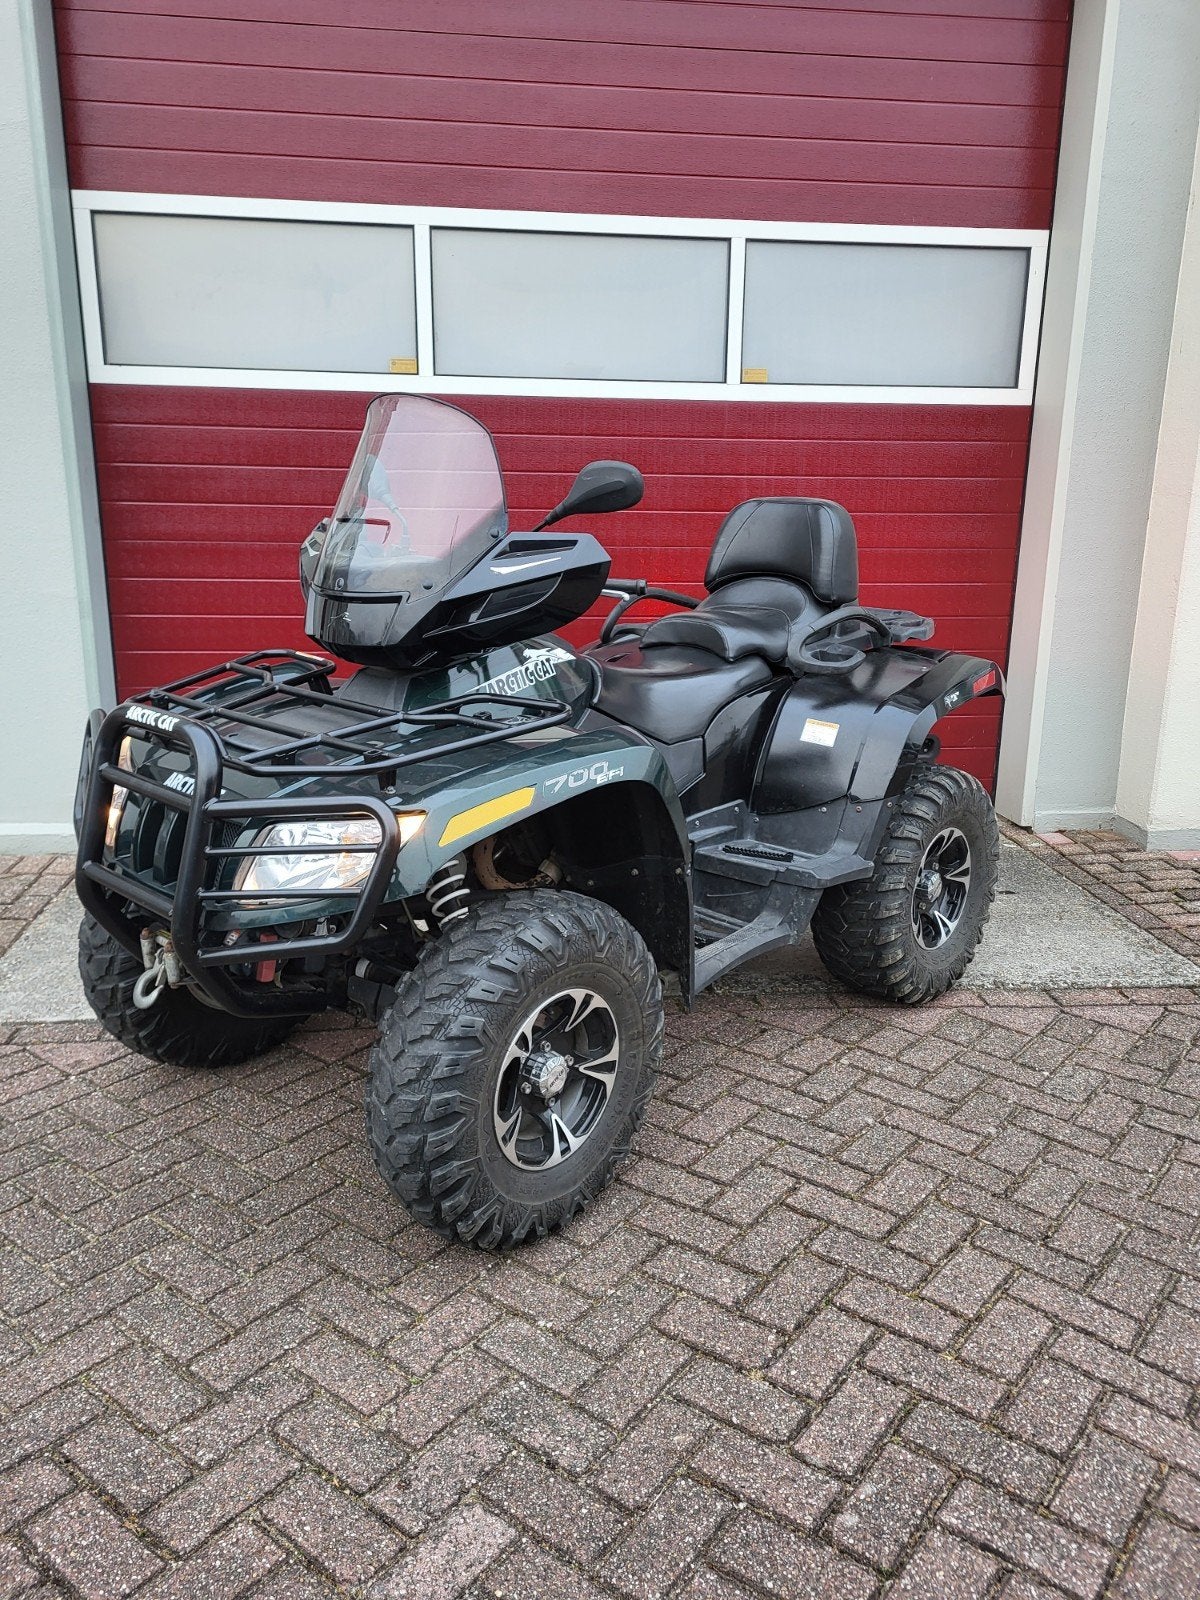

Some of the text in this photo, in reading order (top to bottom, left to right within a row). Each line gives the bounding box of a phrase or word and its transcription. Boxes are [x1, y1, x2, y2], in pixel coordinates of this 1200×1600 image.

[487, 657, 556, 695] ARCTIC CAT
[125, 705, 180, 732] ARCTIC CAT
[163, 771, 196, 796] ARCTI
[545, 760, 609, 794] 700
